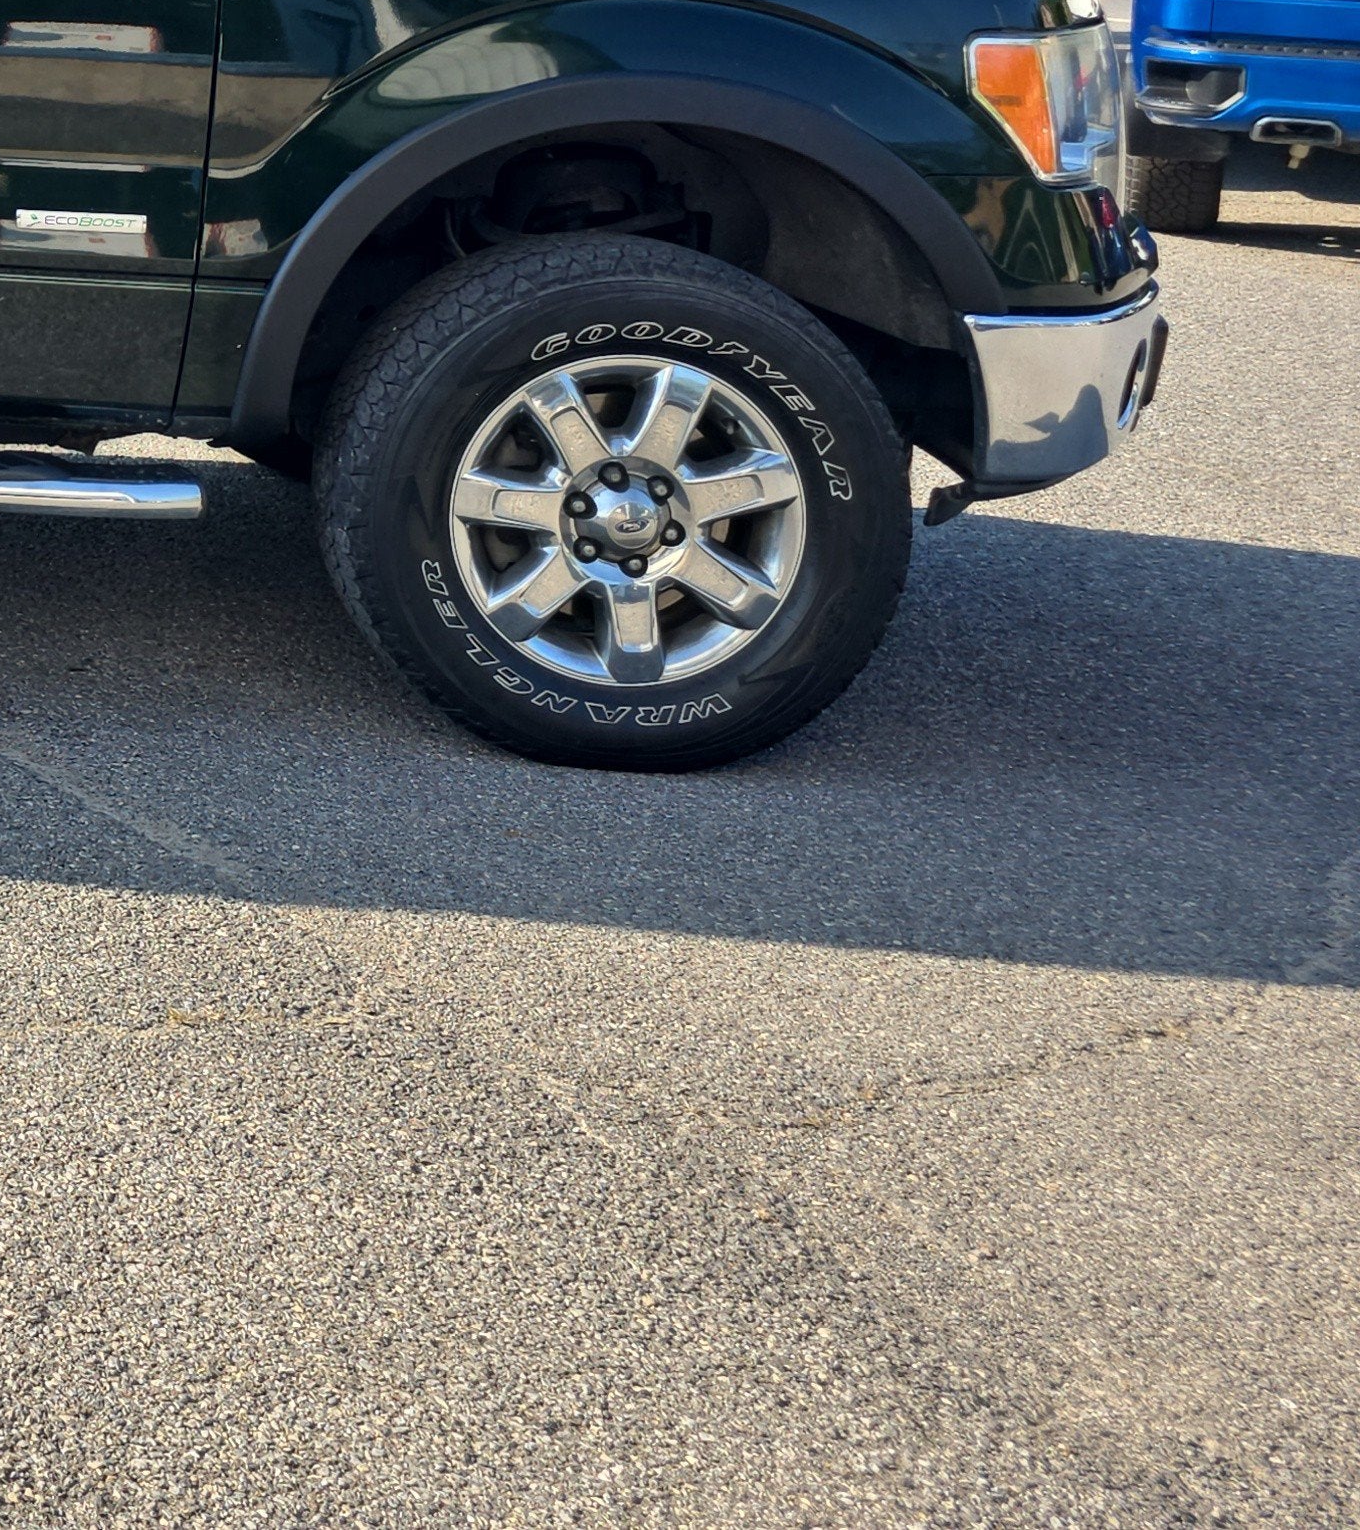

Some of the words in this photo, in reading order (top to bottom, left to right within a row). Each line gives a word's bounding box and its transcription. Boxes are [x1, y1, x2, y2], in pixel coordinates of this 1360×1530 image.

[44, 214, 137, 228] ECOBOOST
[530, 321, 853, 502] GOODYEAR
[421, 559, 733, 726] WRANGLER
